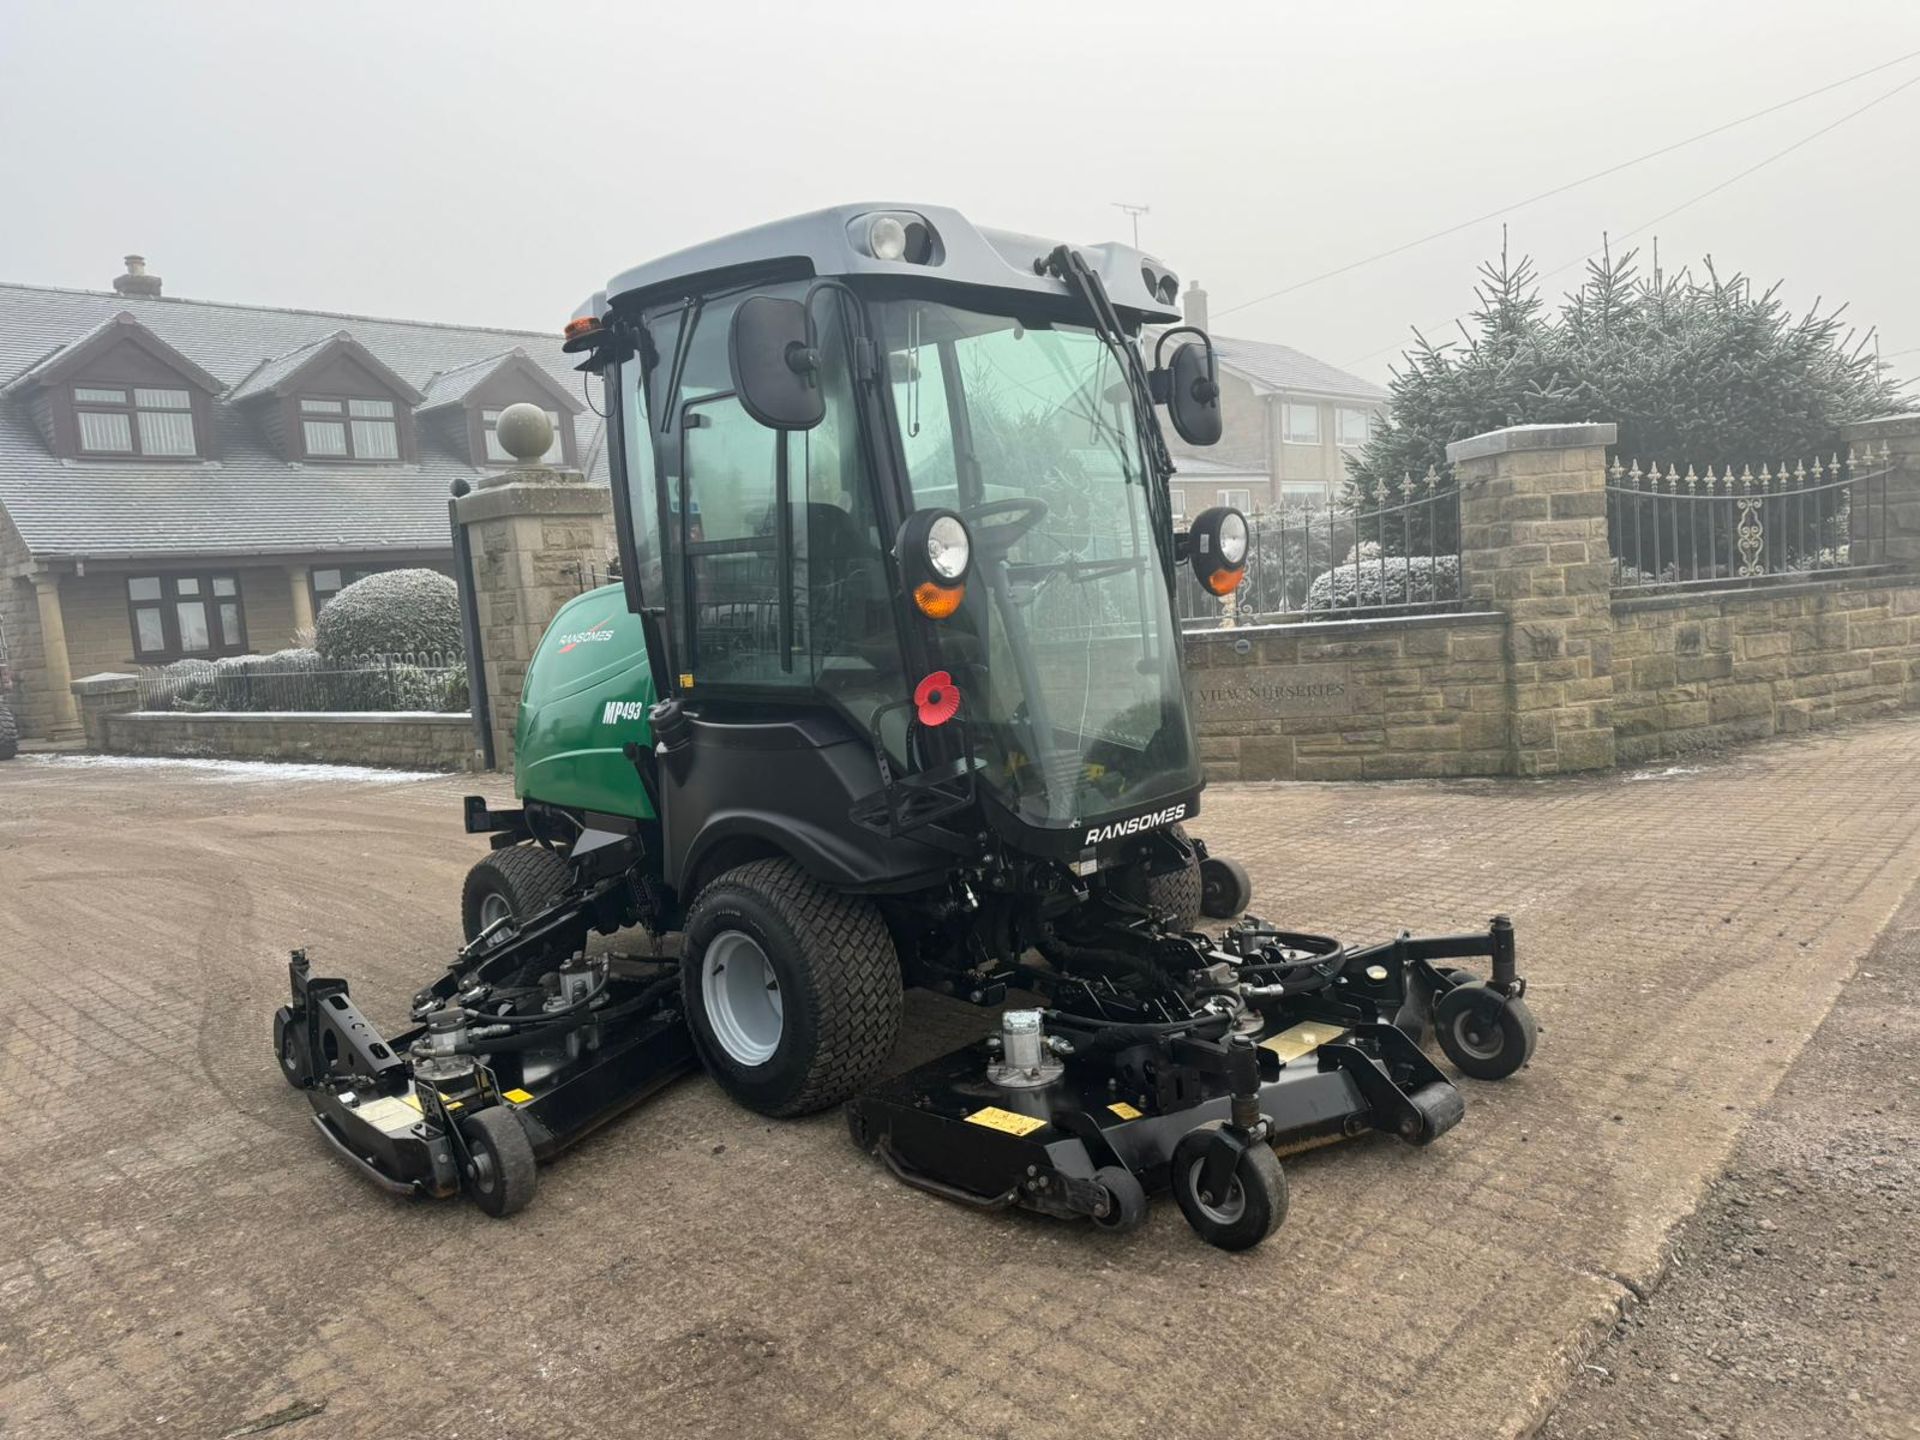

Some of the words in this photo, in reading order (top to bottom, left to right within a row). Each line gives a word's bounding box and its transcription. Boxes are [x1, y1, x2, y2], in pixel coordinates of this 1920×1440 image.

[559, 630, 615, 644] RANSOMES
[1248, 683, 1345, 699] NURSERIES
[602, 701, 642, 725] MP493
[1085, 803, 1187, 845] RANSOMES
